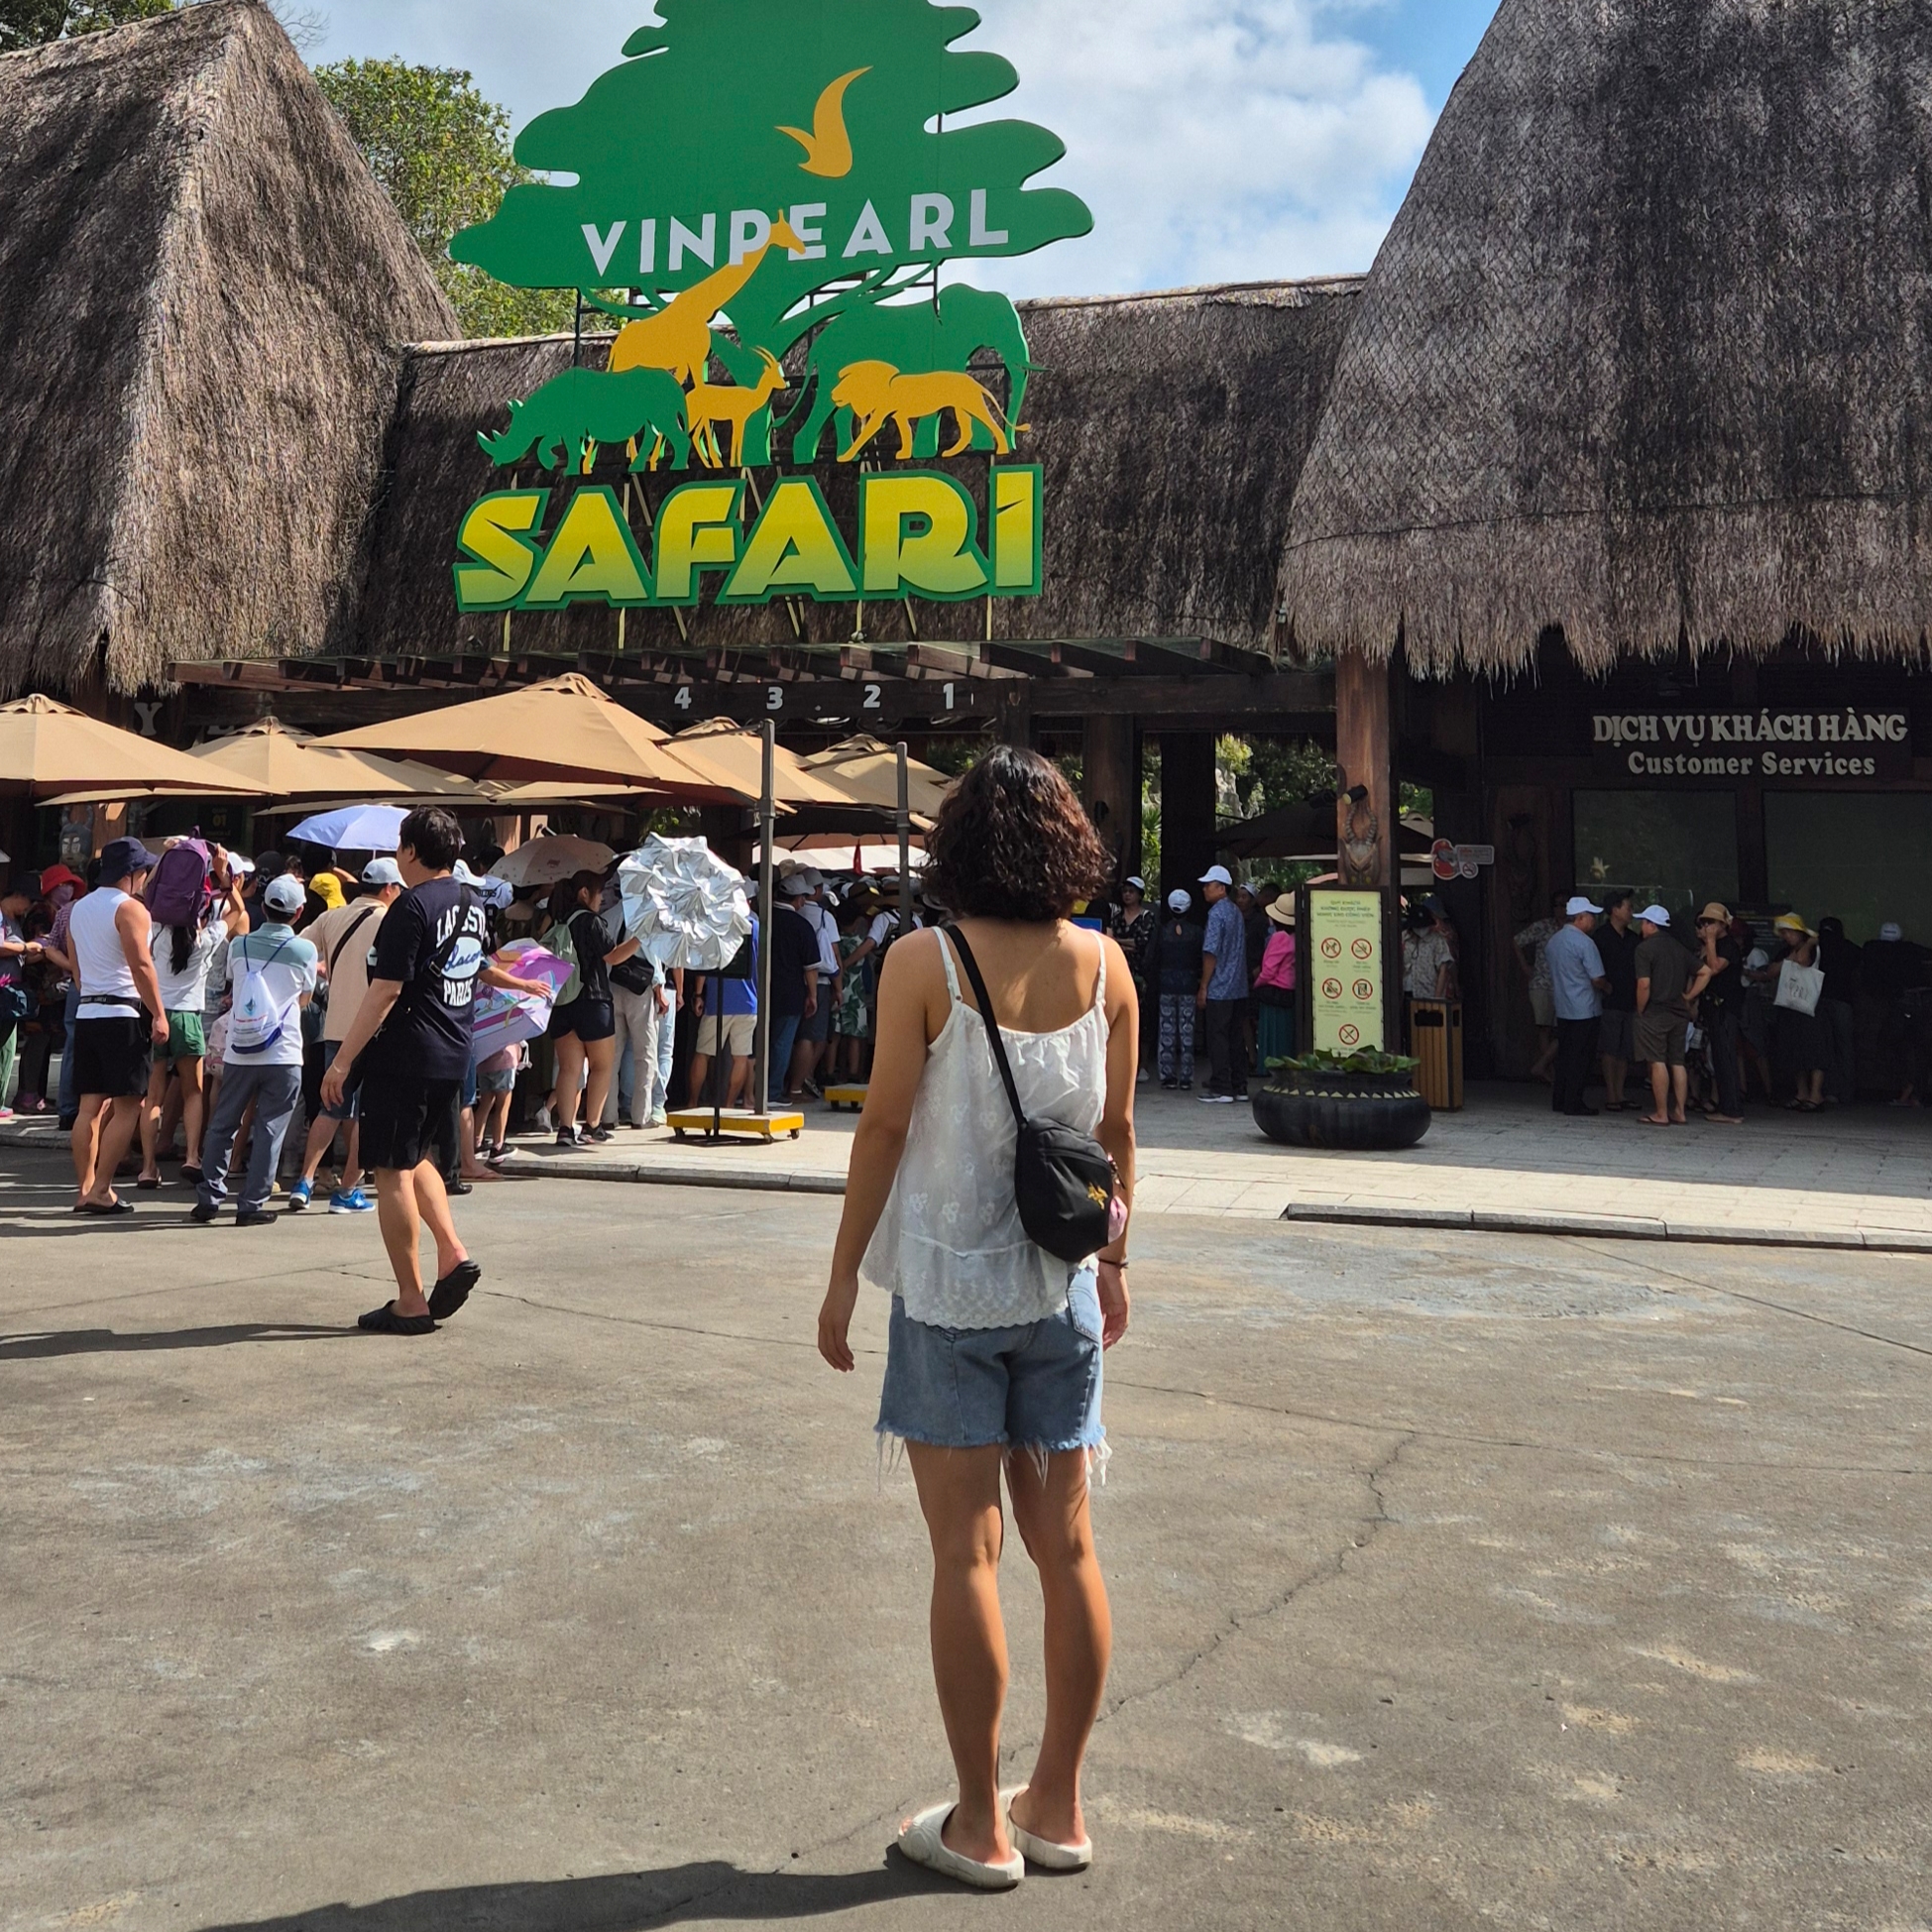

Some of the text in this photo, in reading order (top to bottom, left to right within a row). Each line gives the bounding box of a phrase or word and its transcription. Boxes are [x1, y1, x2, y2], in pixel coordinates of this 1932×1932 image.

[581, 188, 1009, 278] VINPEARL
[456, 468, 1038, 607] SAFARI
[674, 686, 692, 709] 4
[766, 686, 783, 710] 3
[863, 684, 881, 708] 2
[943, 683, 955, 709] 1
[1593, 707, 1908, 747] DỊCH VỤ KHÁCH HÀNG
[1628, 750, 1875, 775] Customer Services
[443, 977, 474, 1007] PARIS
